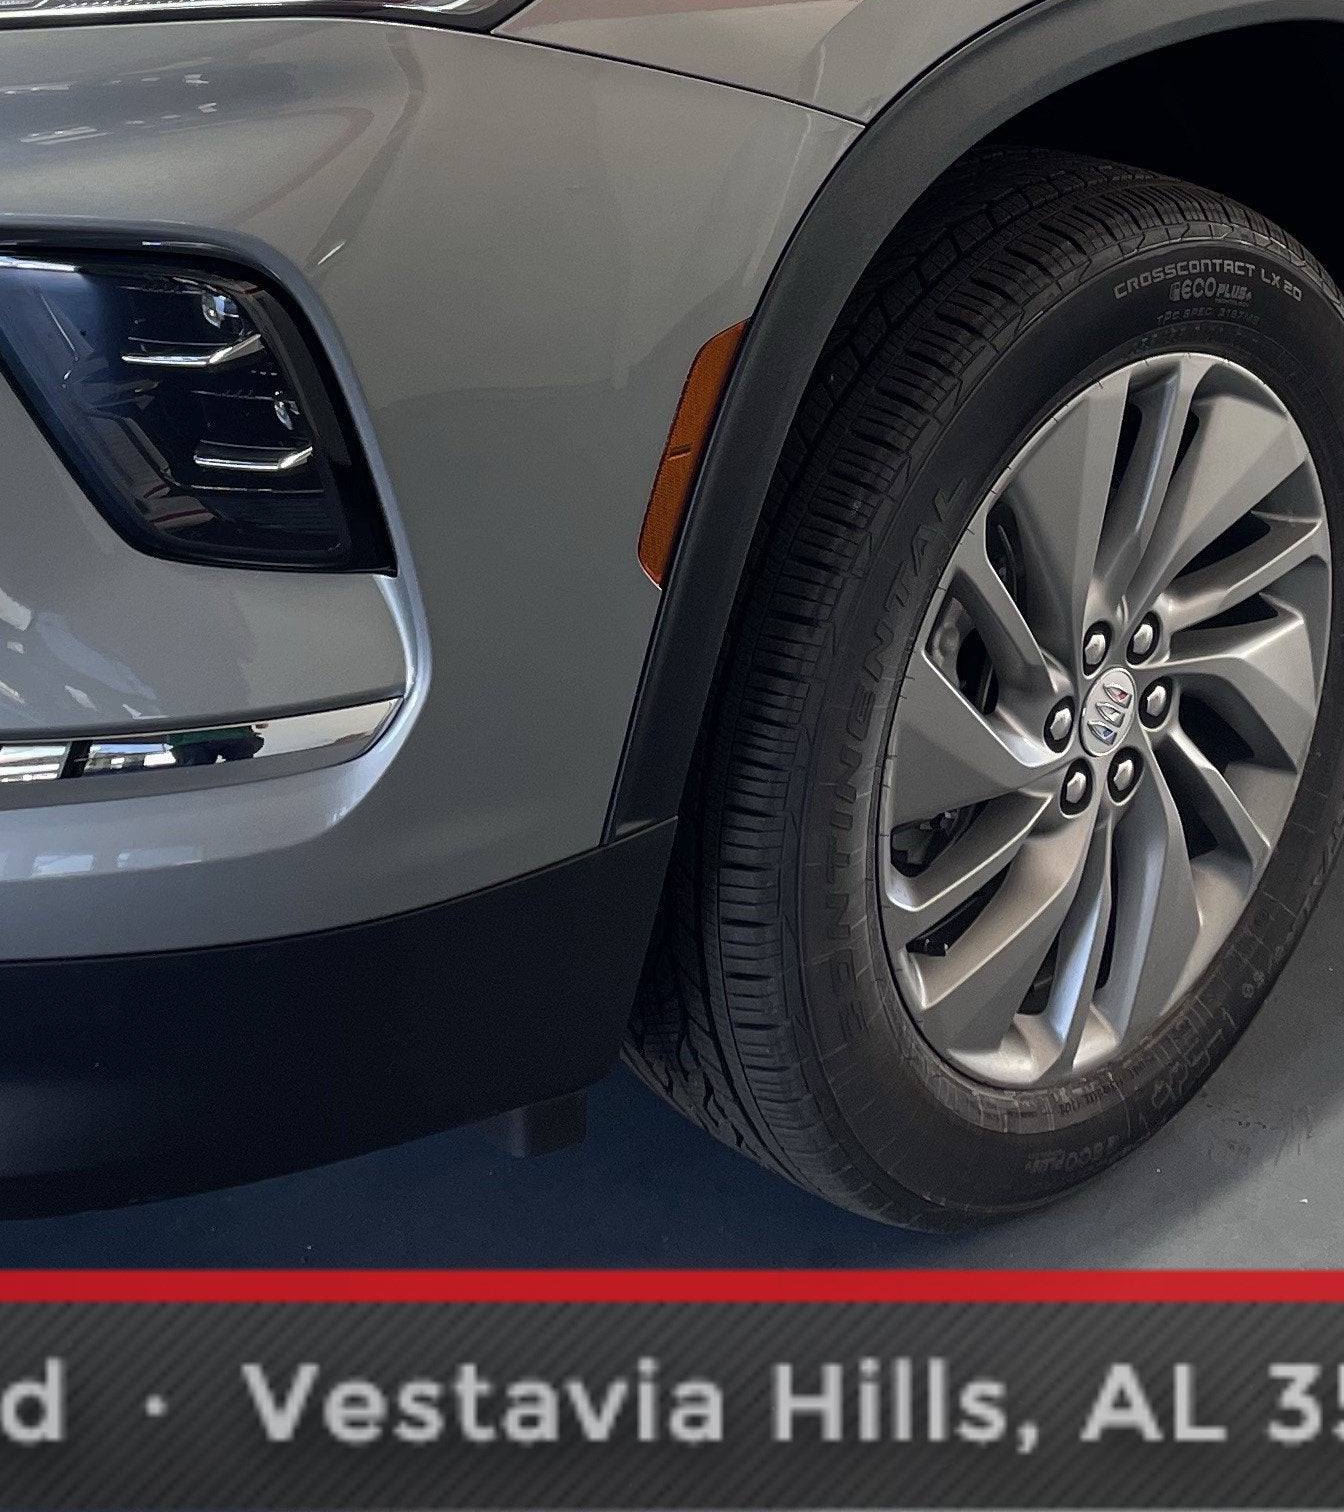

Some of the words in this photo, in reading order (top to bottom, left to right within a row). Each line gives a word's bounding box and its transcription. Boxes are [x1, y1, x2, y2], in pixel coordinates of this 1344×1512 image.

[1112, 258, 1256, 300] CROSSCONTACT
[1260, 268, 1281, 287] LX
[1283, 284, 1303, 302] 20
